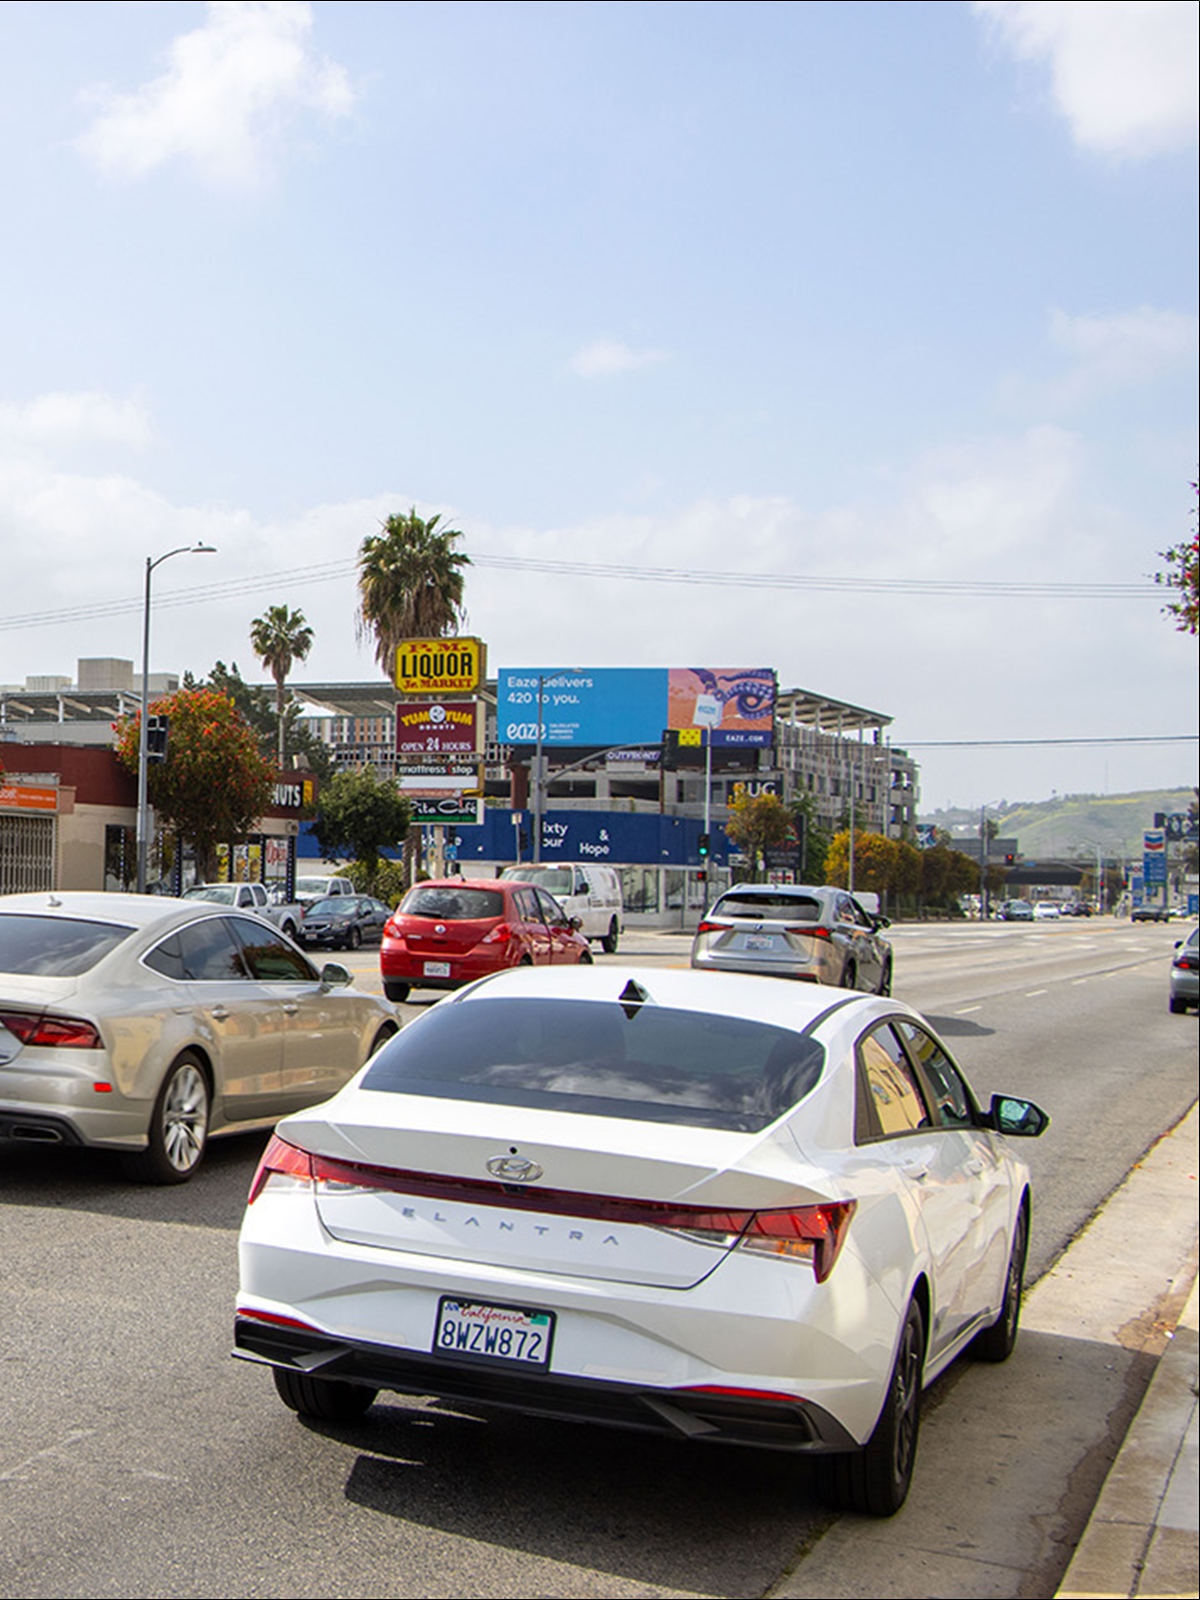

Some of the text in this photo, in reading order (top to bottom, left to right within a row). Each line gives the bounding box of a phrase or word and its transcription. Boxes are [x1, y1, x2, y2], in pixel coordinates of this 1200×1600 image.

[402, 652, 472, 679] LIQUOR
[421, 679, 473, 688] MARKET
[507, 676, 538, 688] Eaze
[507, 692, 532, 704] 420
[552, 693, 580, 706] you.
[401, 710, 473, 727] YUM YUM
[506, 723, 547, 740] eaze
[725, 734, 764, 742] EAZE.COM
[400, 737, 472, 752] OPEN 24 HOURS
[451, 764, 473, 776] stop
[542, 821, 569, 837] ixty
[599, 829, 609, 841] &
[542, 838, 564, 848] our
[579, 842, 610, 857] Hope
[402, 1207, 619, 1246] ELANTRA
[460, 1305, 531, 1326] California
[441, 1319, 542, 1360] 8WZW872
